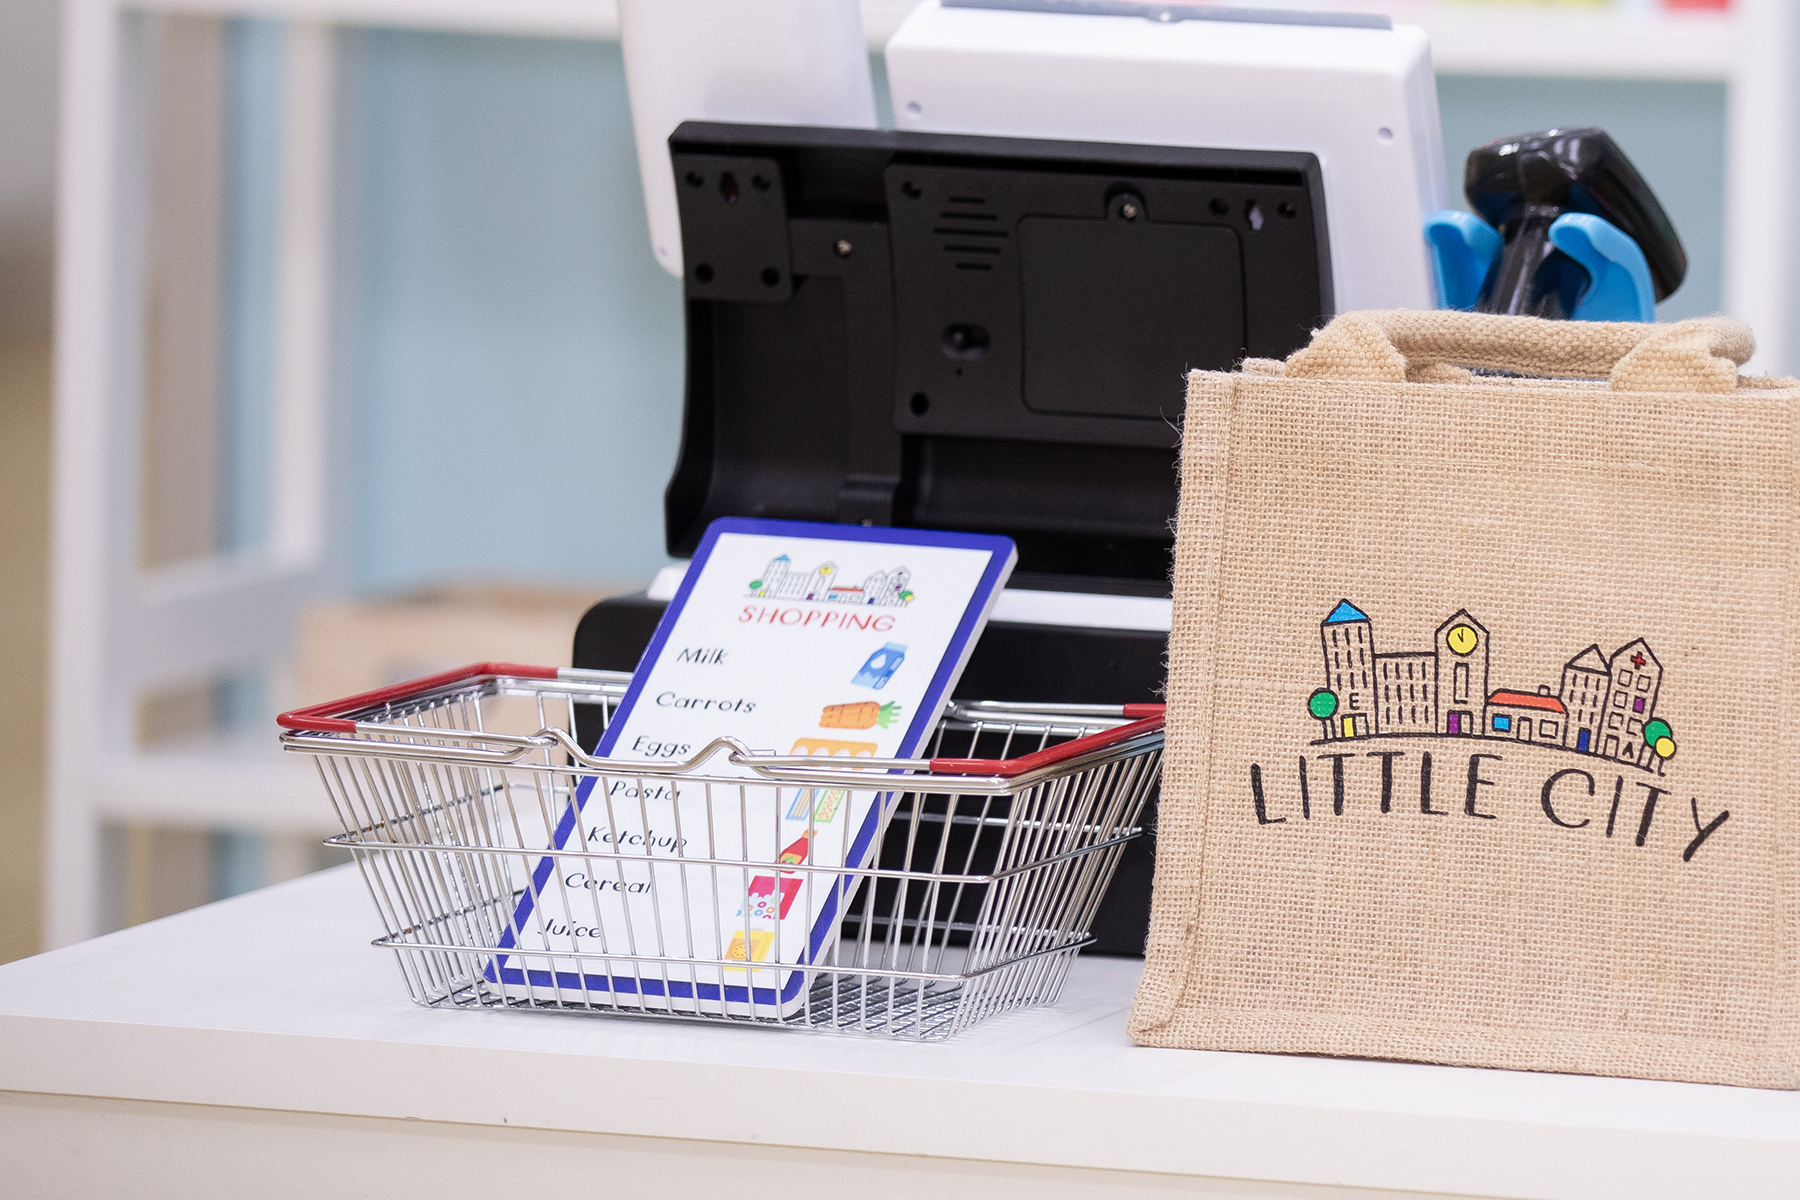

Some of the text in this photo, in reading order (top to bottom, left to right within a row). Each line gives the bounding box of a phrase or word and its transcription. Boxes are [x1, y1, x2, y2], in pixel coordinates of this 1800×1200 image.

[738, 604, 897, 633] SHOPPING
[677, 646, 729, 666] Milk
[656, 690, 757, 715] Carrots
[631, 734, 692, 758] Eggs
[610, 780, 683, 802] Pasta
[1250, 750, 1730, 862] LITTLE CITY
[588, 825, 688, 854] Ketchup
[564, 871, 652, 895] Cereal
[537, 918, 602, 939] Juice
